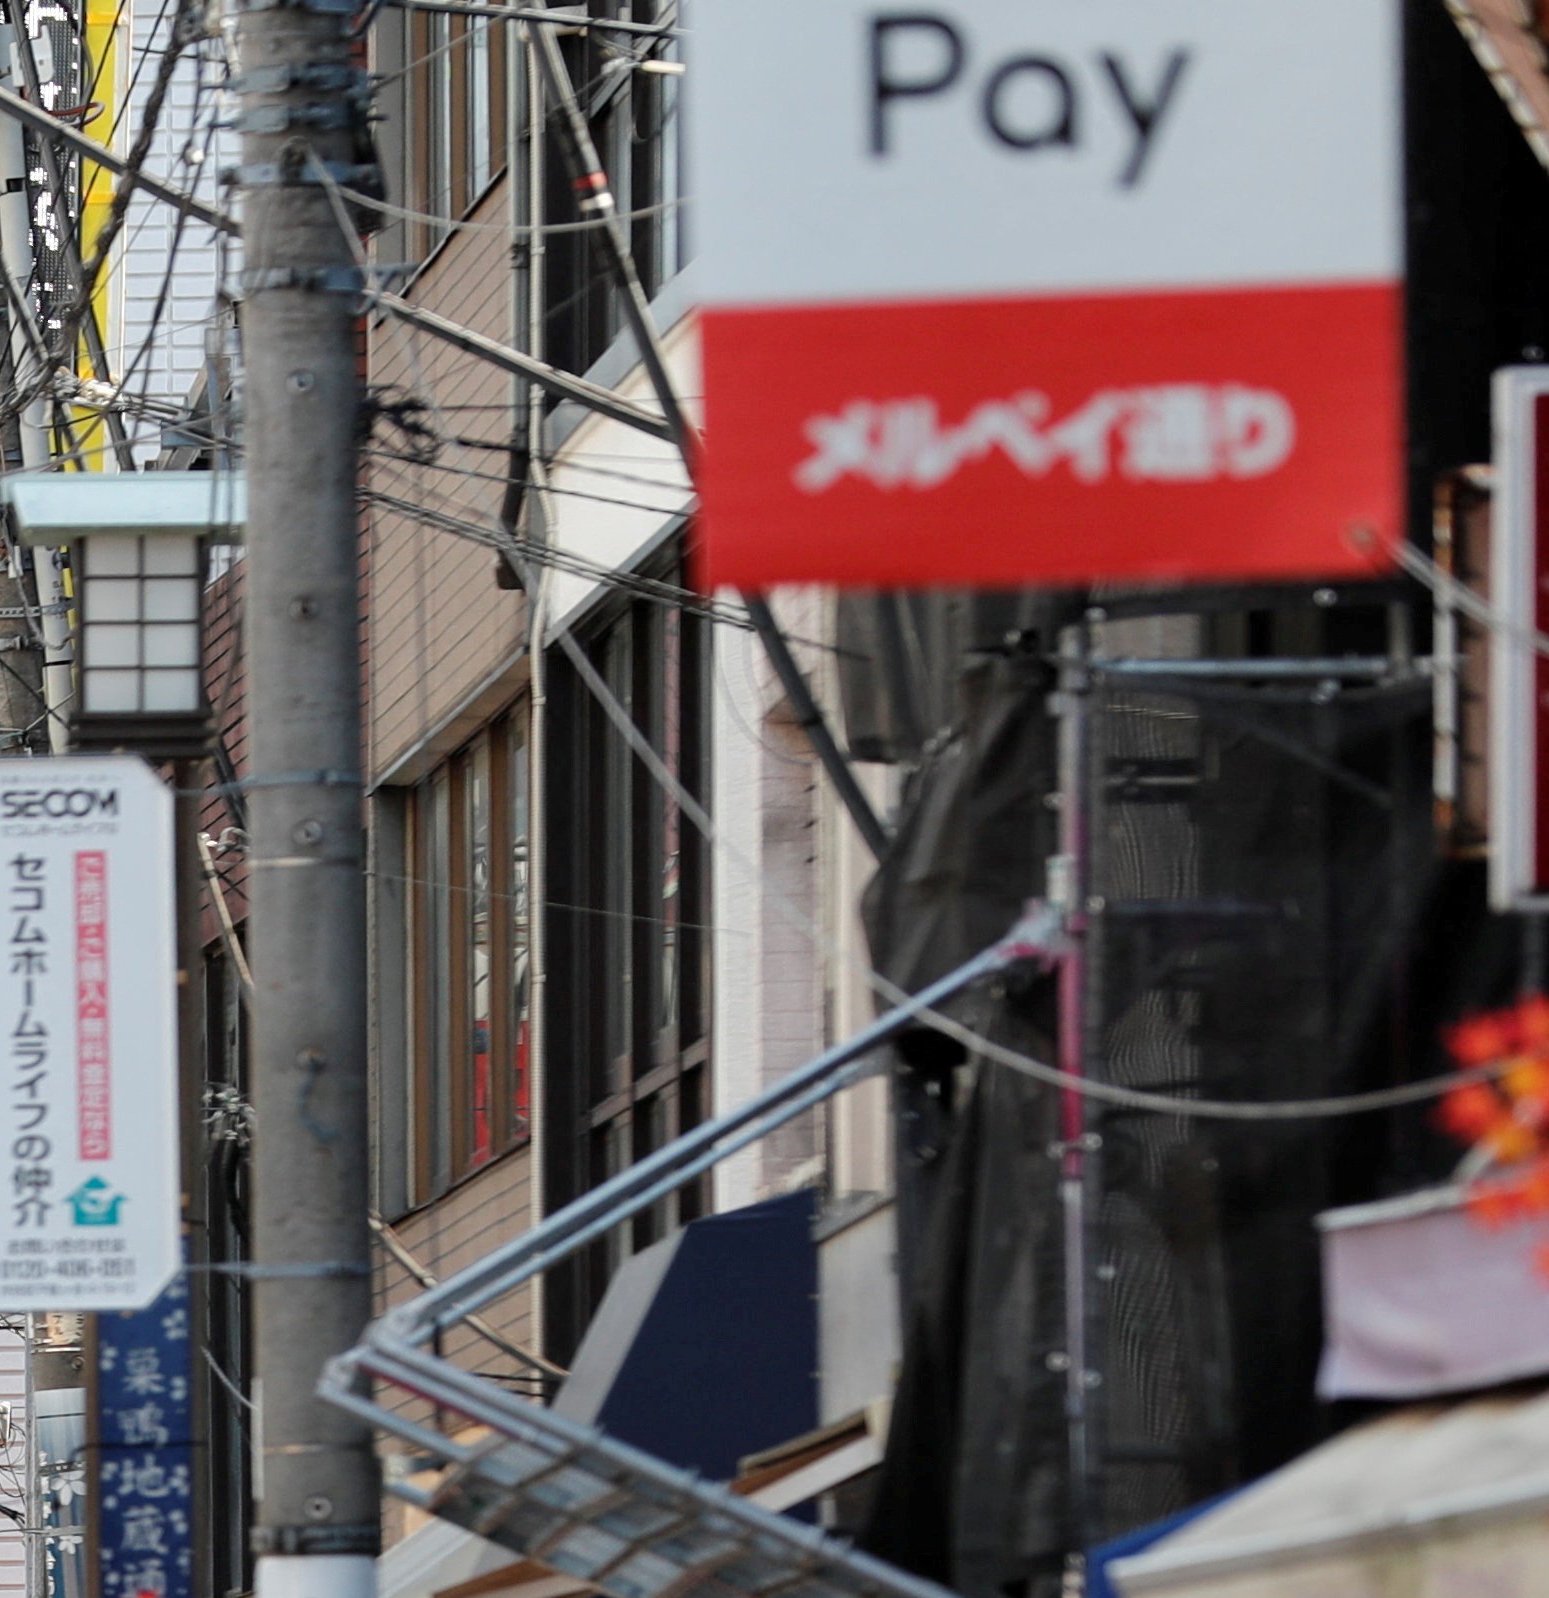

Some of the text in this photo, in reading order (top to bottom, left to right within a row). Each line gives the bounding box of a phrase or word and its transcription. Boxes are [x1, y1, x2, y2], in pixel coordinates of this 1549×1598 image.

[864, 10, 1193, 190] Pay
[794, 385, 1297, 491] メルペイ通り
[0, 789, 119, 818] SECOM
[10, 852, 53, 1227] セコムホームライフの仲介
